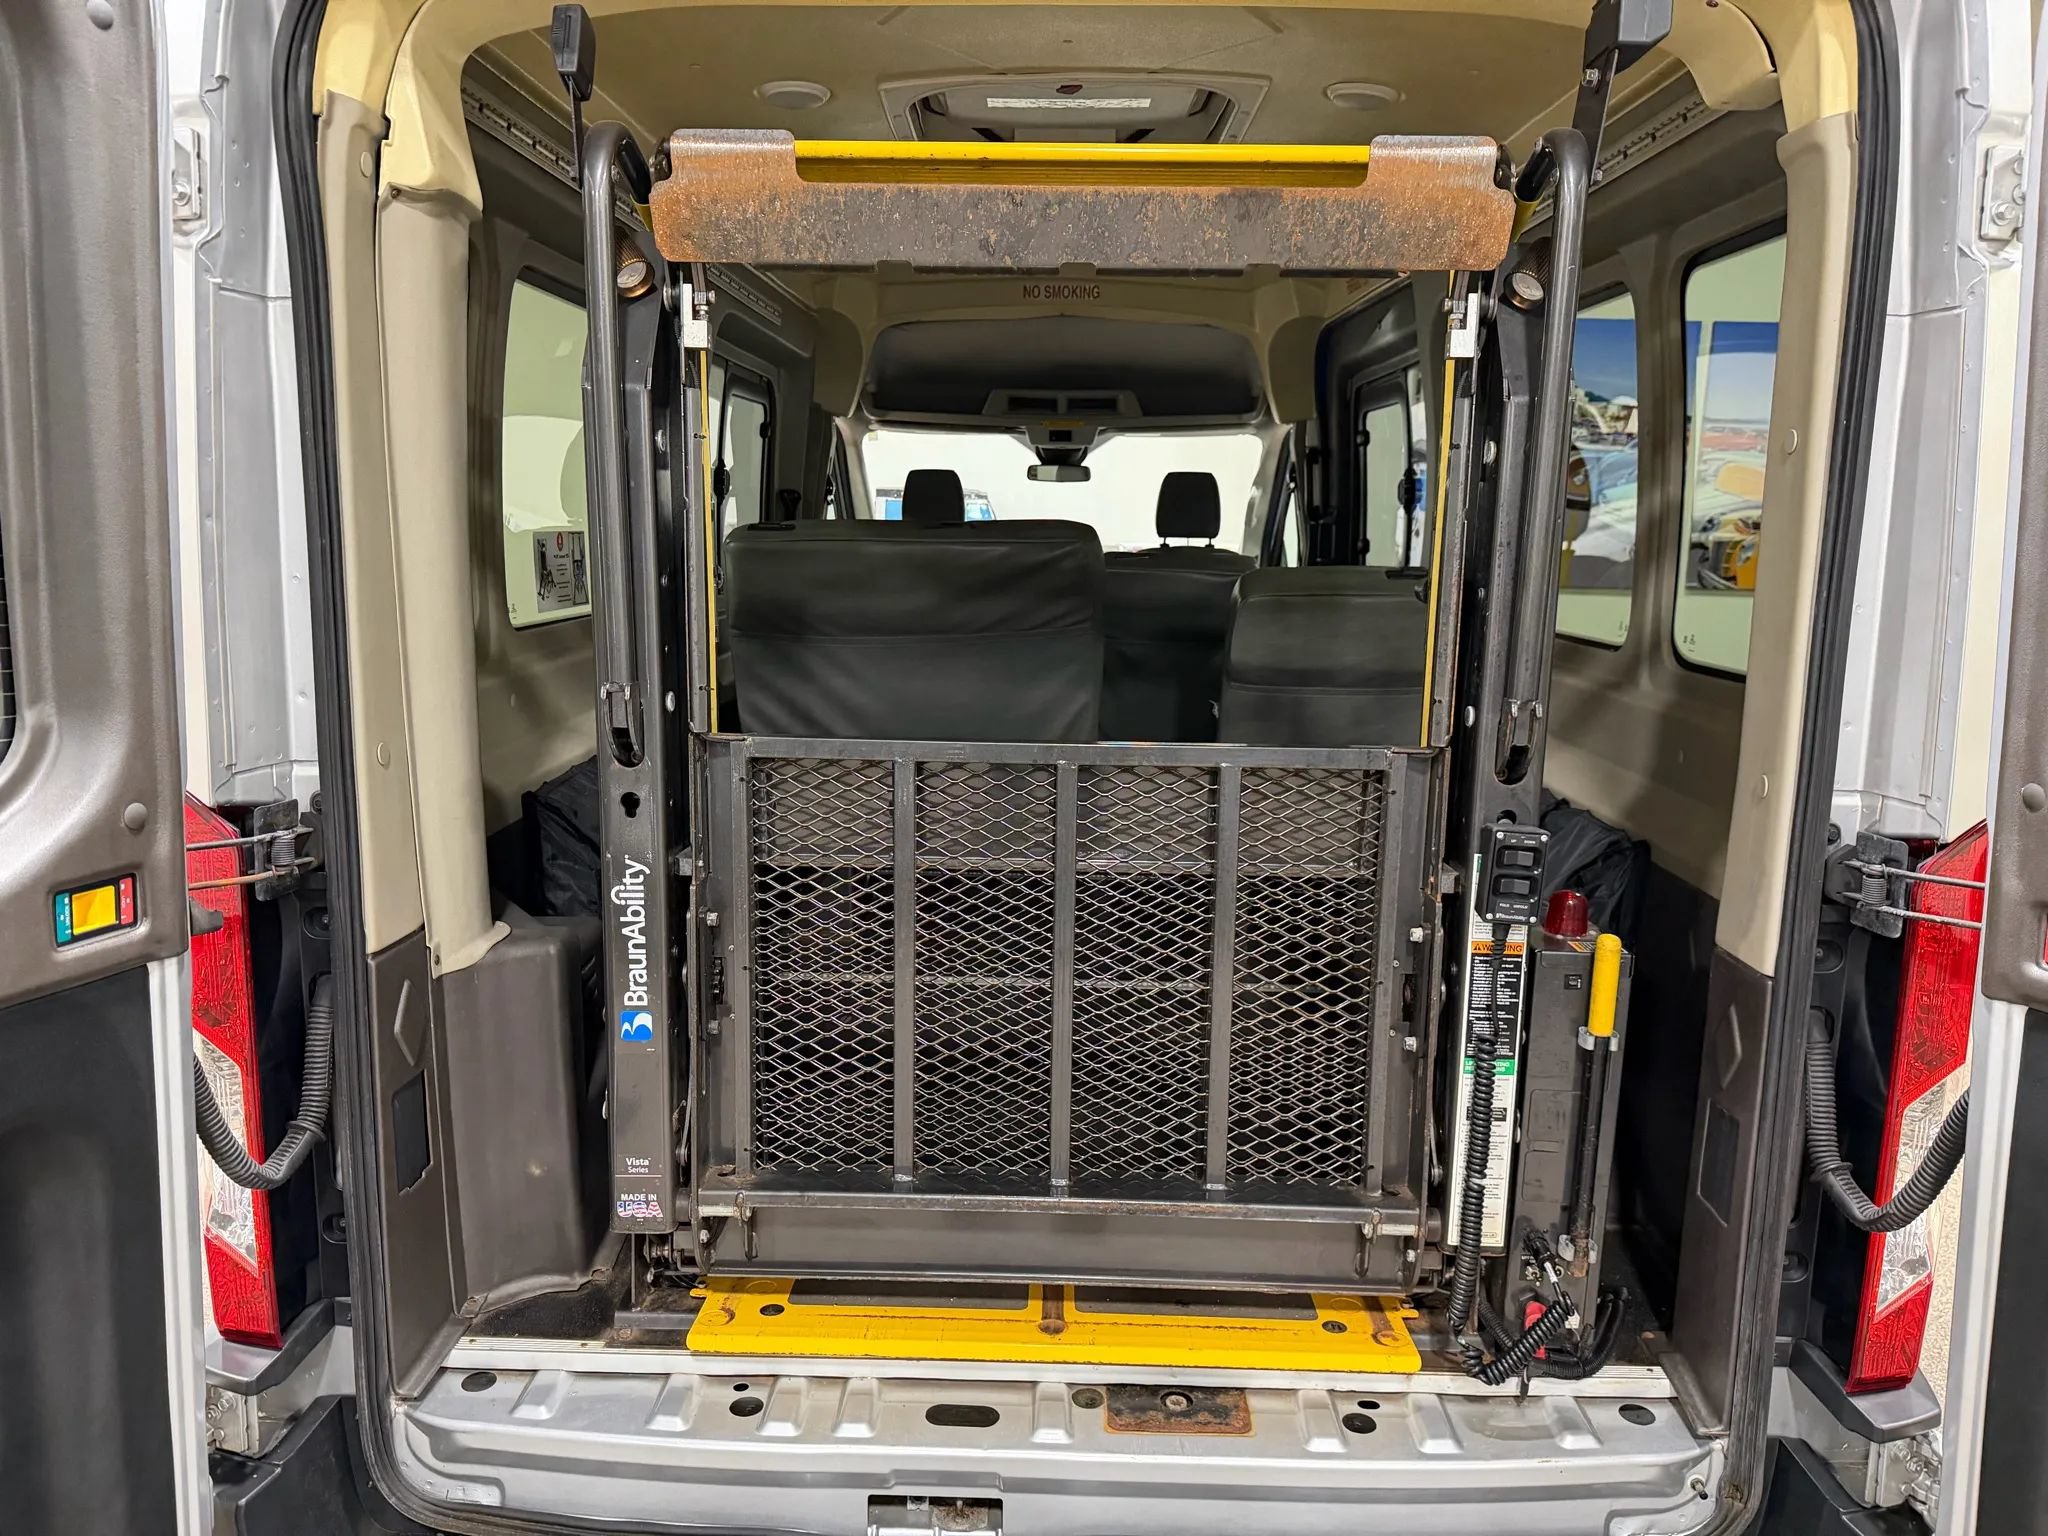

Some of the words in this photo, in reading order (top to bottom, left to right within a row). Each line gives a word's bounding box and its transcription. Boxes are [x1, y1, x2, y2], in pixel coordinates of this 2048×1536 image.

[1023, 284, 1041, 299] NO
[1044, 284, 1100, 299] SMOKING
[611, 854, 651, 1006] BraunAbility
[626, 1157, 649, 1166] Vista
[616, 1201, 664, 1217] USA
